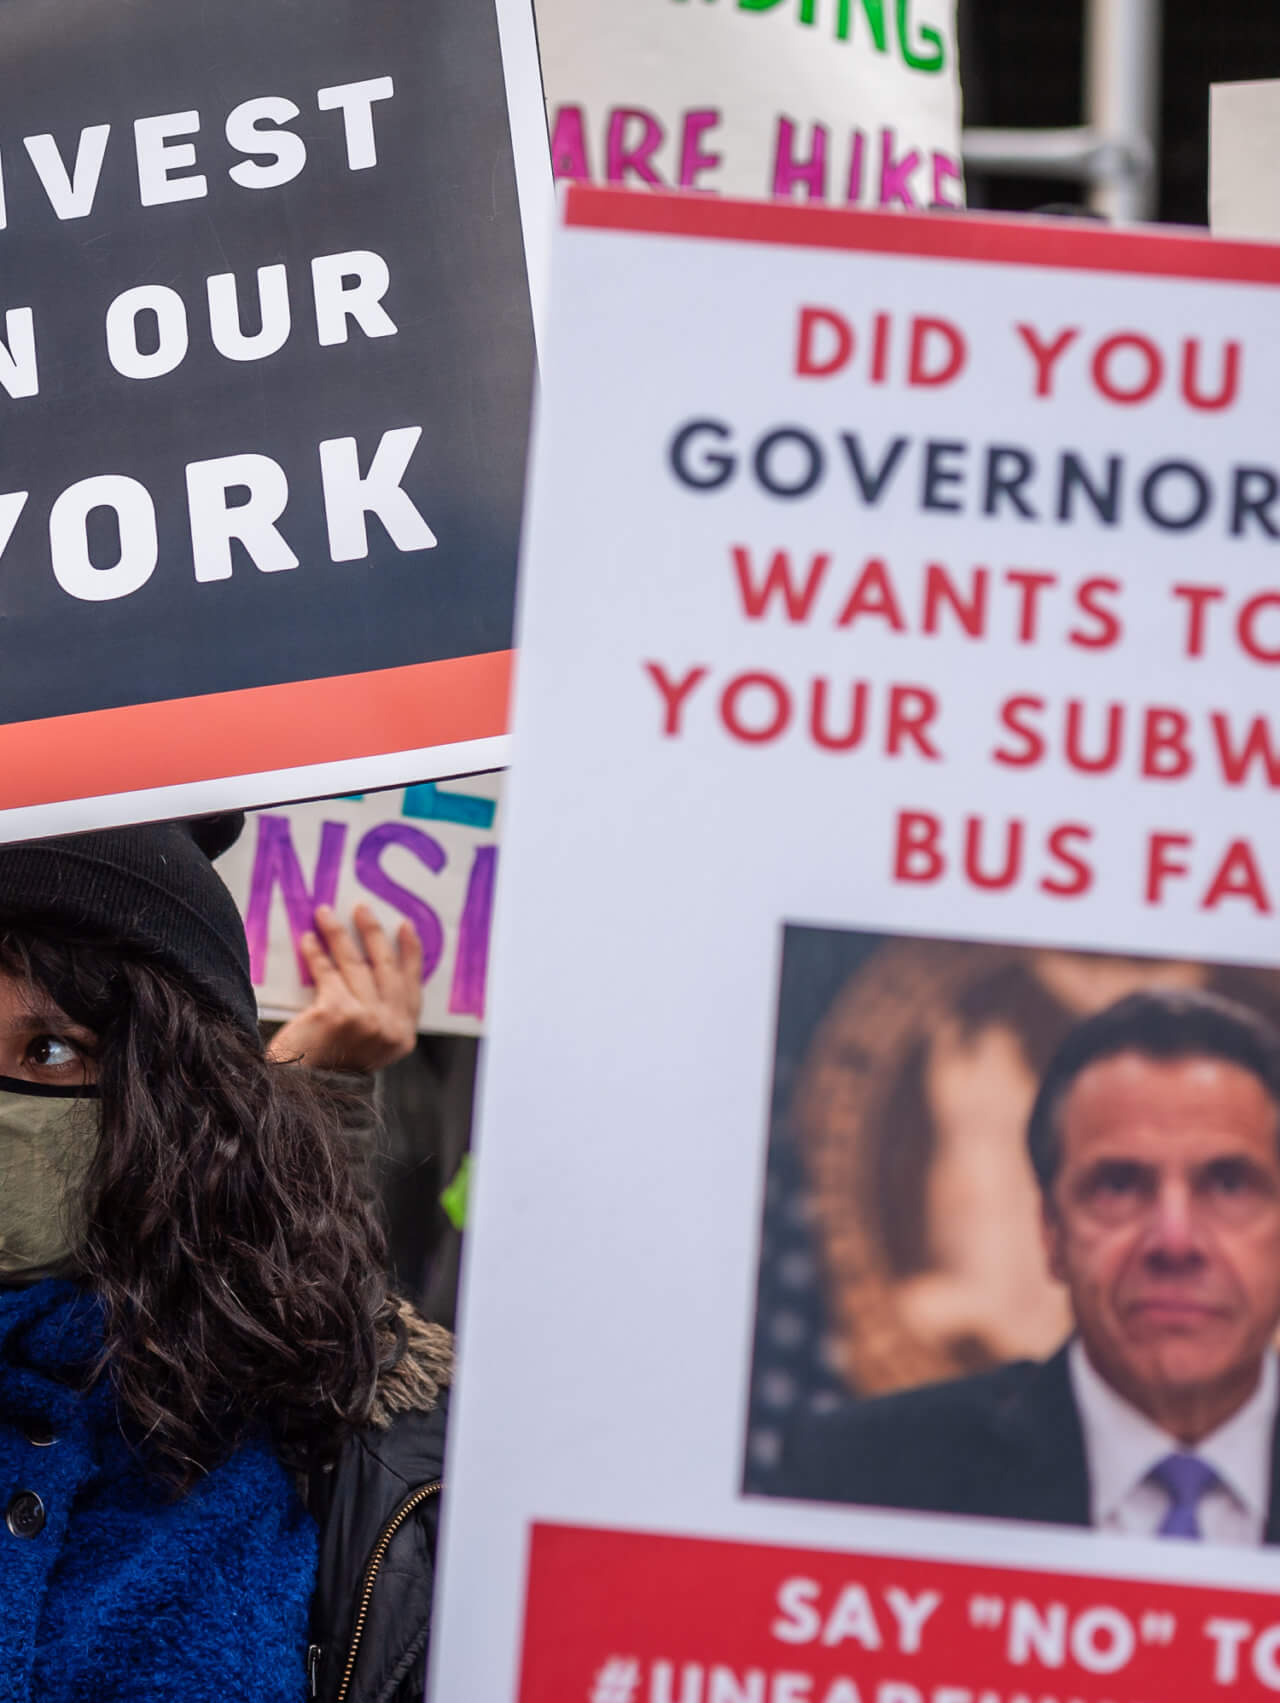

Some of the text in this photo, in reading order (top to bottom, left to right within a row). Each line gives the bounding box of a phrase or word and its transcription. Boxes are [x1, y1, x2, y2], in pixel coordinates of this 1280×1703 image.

[106, 250, 399, 379] OUR
[794, 306, 1242, 413] DID YOU
[668, 418, 1280, 541] GOVERNOR
[730, 545, 1122, 652] WANTS
[644, 661, 1280, 790] YOUR SUBW
[893, 810, 1274, 915] BUS FA
[771, 1576, 941, 1654] SAY
[968, 1595, 1176, 1673] "NO"
